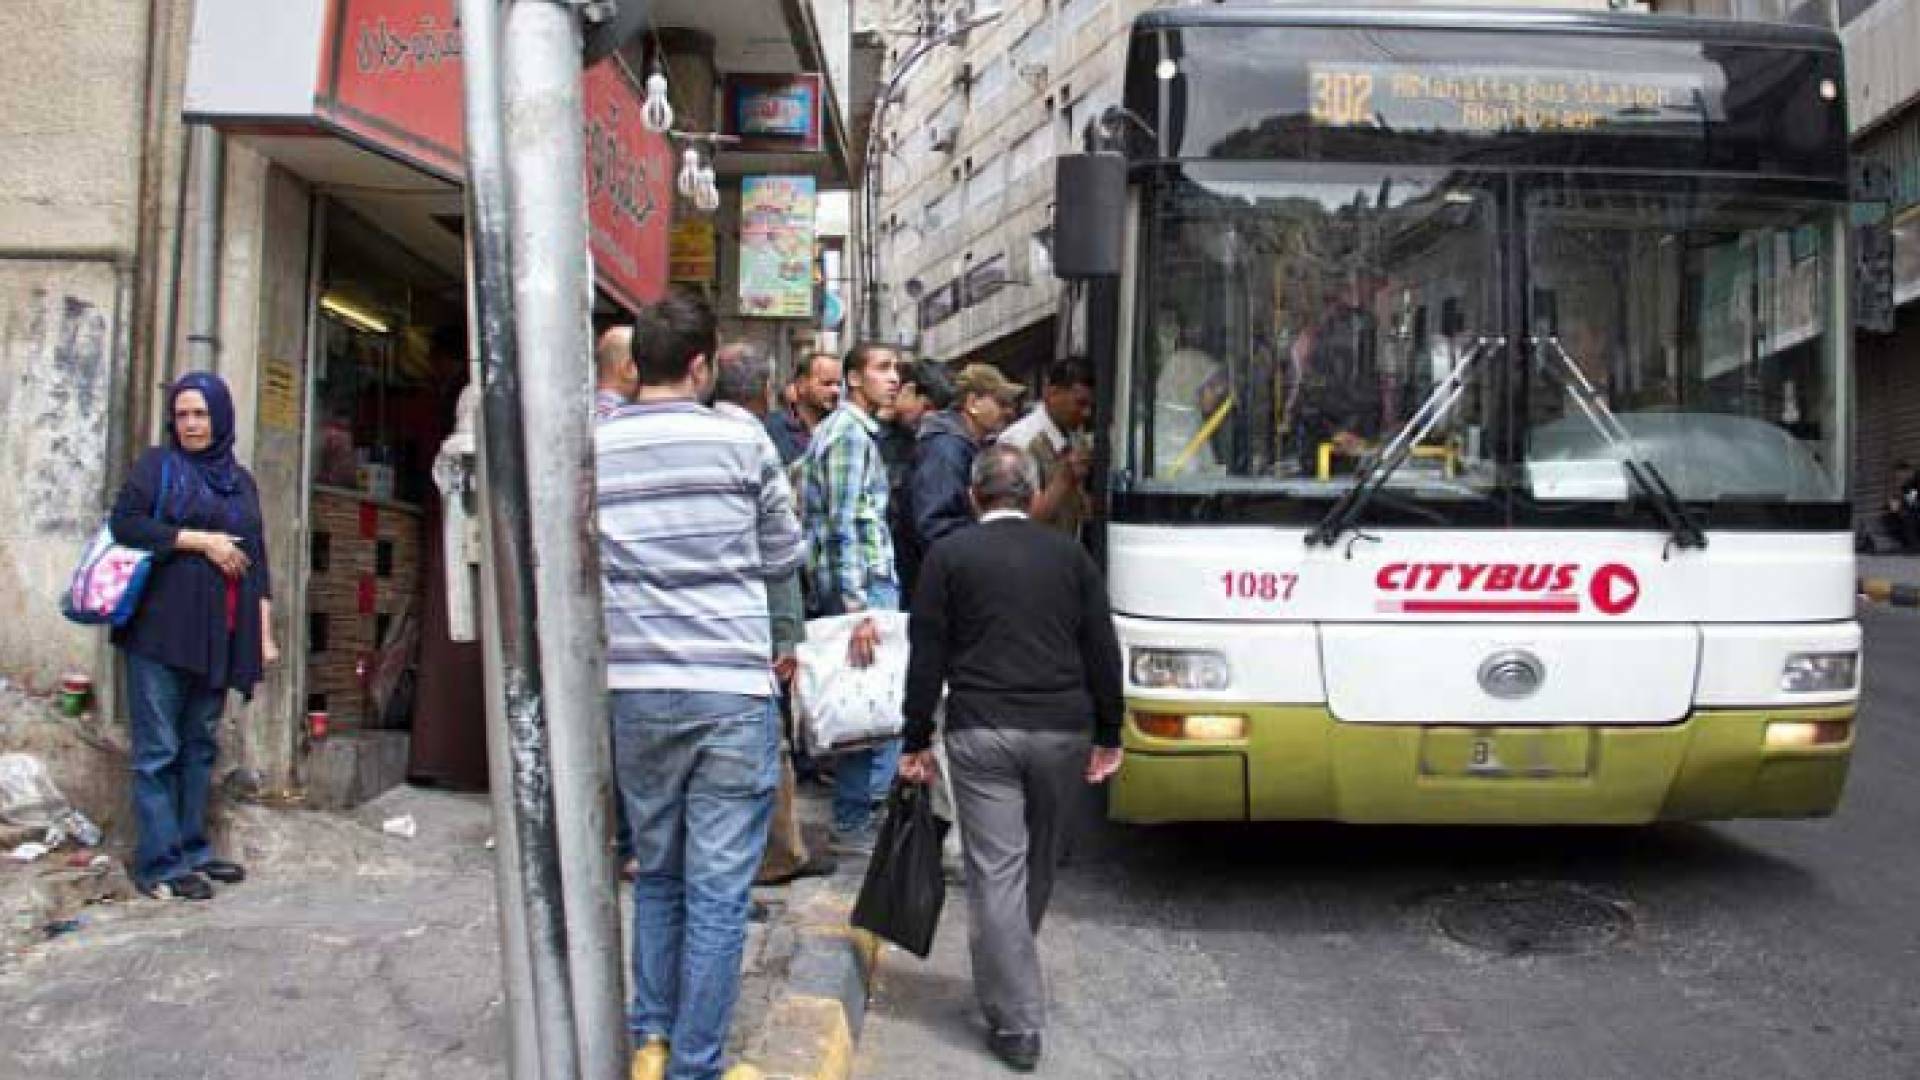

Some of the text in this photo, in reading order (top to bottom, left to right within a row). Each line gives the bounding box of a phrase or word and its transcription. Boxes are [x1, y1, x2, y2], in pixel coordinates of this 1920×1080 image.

[1311, 72, 1372, 122] 302
[1220, 569, 1299, 601] 1087
[1375, 562, 1581, 592] CITYBUS
